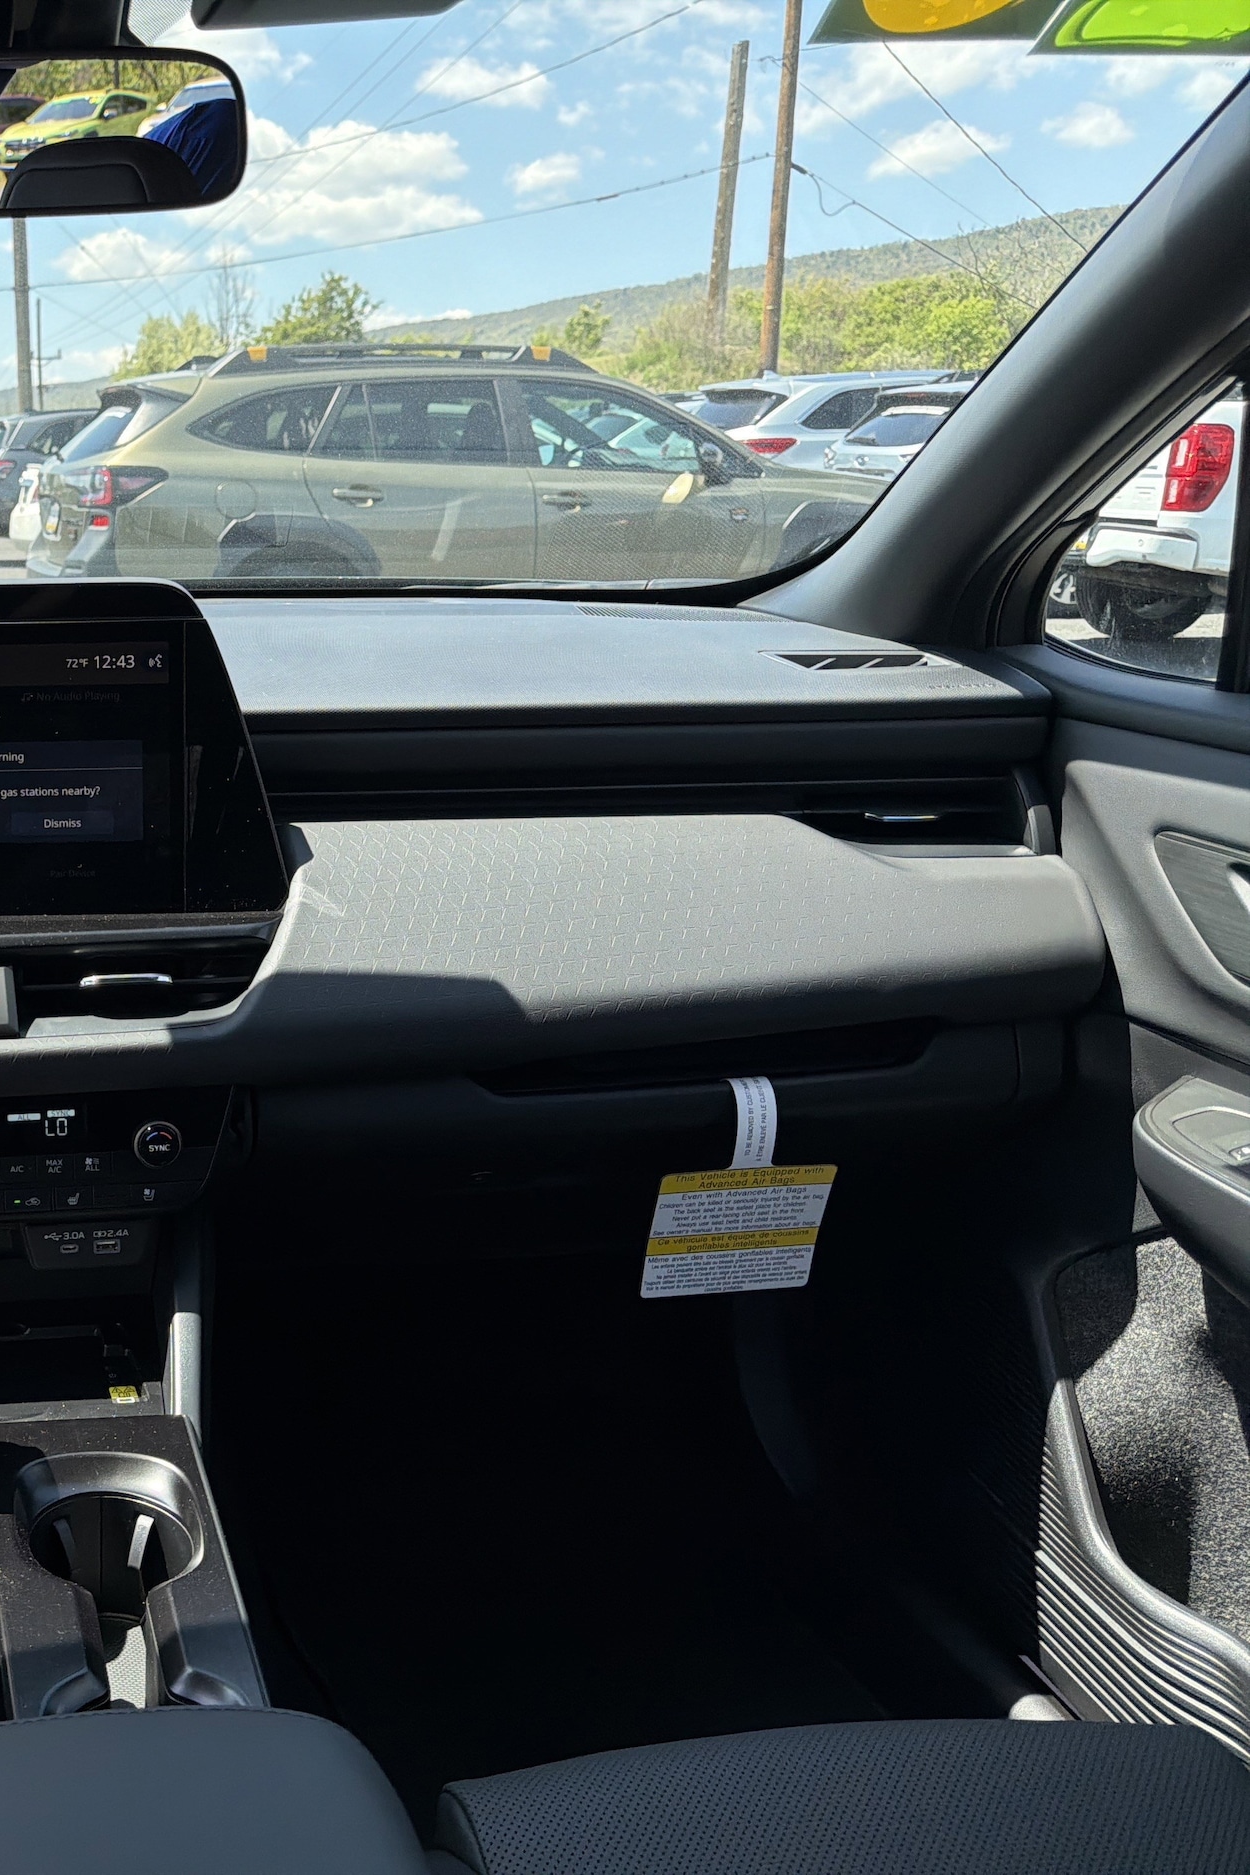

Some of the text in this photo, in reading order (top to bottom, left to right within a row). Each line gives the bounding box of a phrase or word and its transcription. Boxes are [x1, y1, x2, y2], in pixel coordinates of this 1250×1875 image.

[94, 655, 135, 668] 12:43
[0, 789, 17, 800] gas
[20, 787, 59, 797] stations
[62, 786, 100, 798] nearby?
[44, 818, 81, 828] Dismiss
[44, 1118, 68, 1136] LO
[149, 1144, 171, 1152] SYNC
[699, 1171, 736, 1180] Vehicle
[752, 1167, 800, 1178] Equipped
[698, 1178, 748, 1188] Advanced
[769, 1175, 796, 1185] Bags
[725, 1188, 768, 1197] Advanced
[784, 1186, 807, 1194] Bags
[62, 1232, 85, 1240] 3.0A
[106, 1229, 129, 1238] 2.4A
[772, 1228, 810, 1237] coussins
